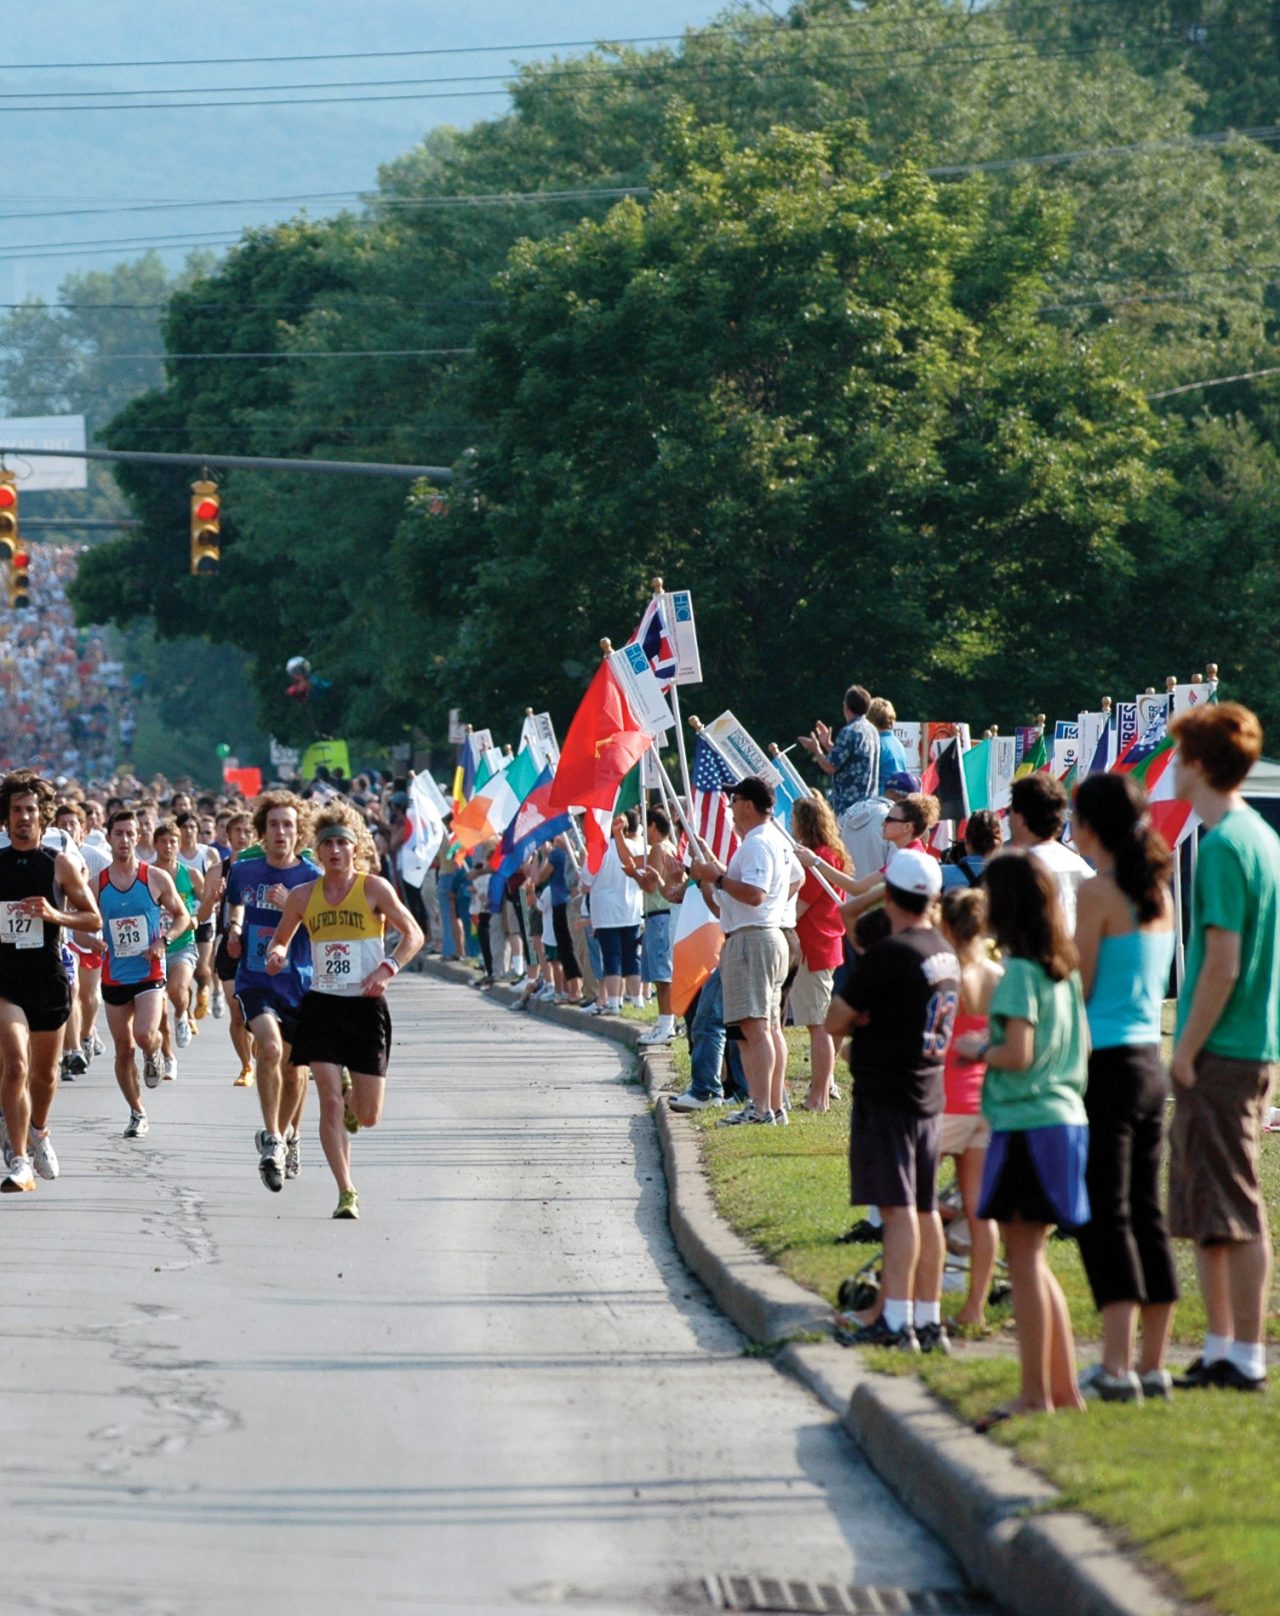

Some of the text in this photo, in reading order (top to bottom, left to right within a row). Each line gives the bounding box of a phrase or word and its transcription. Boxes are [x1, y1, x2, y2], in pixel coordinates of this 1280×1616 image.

[7, 918, 32, 933] 127
[309, 909, 365, 934] ALFRED STATE
[118, 931, 140, 944] 213
[325, 959, 351, 974] 238
